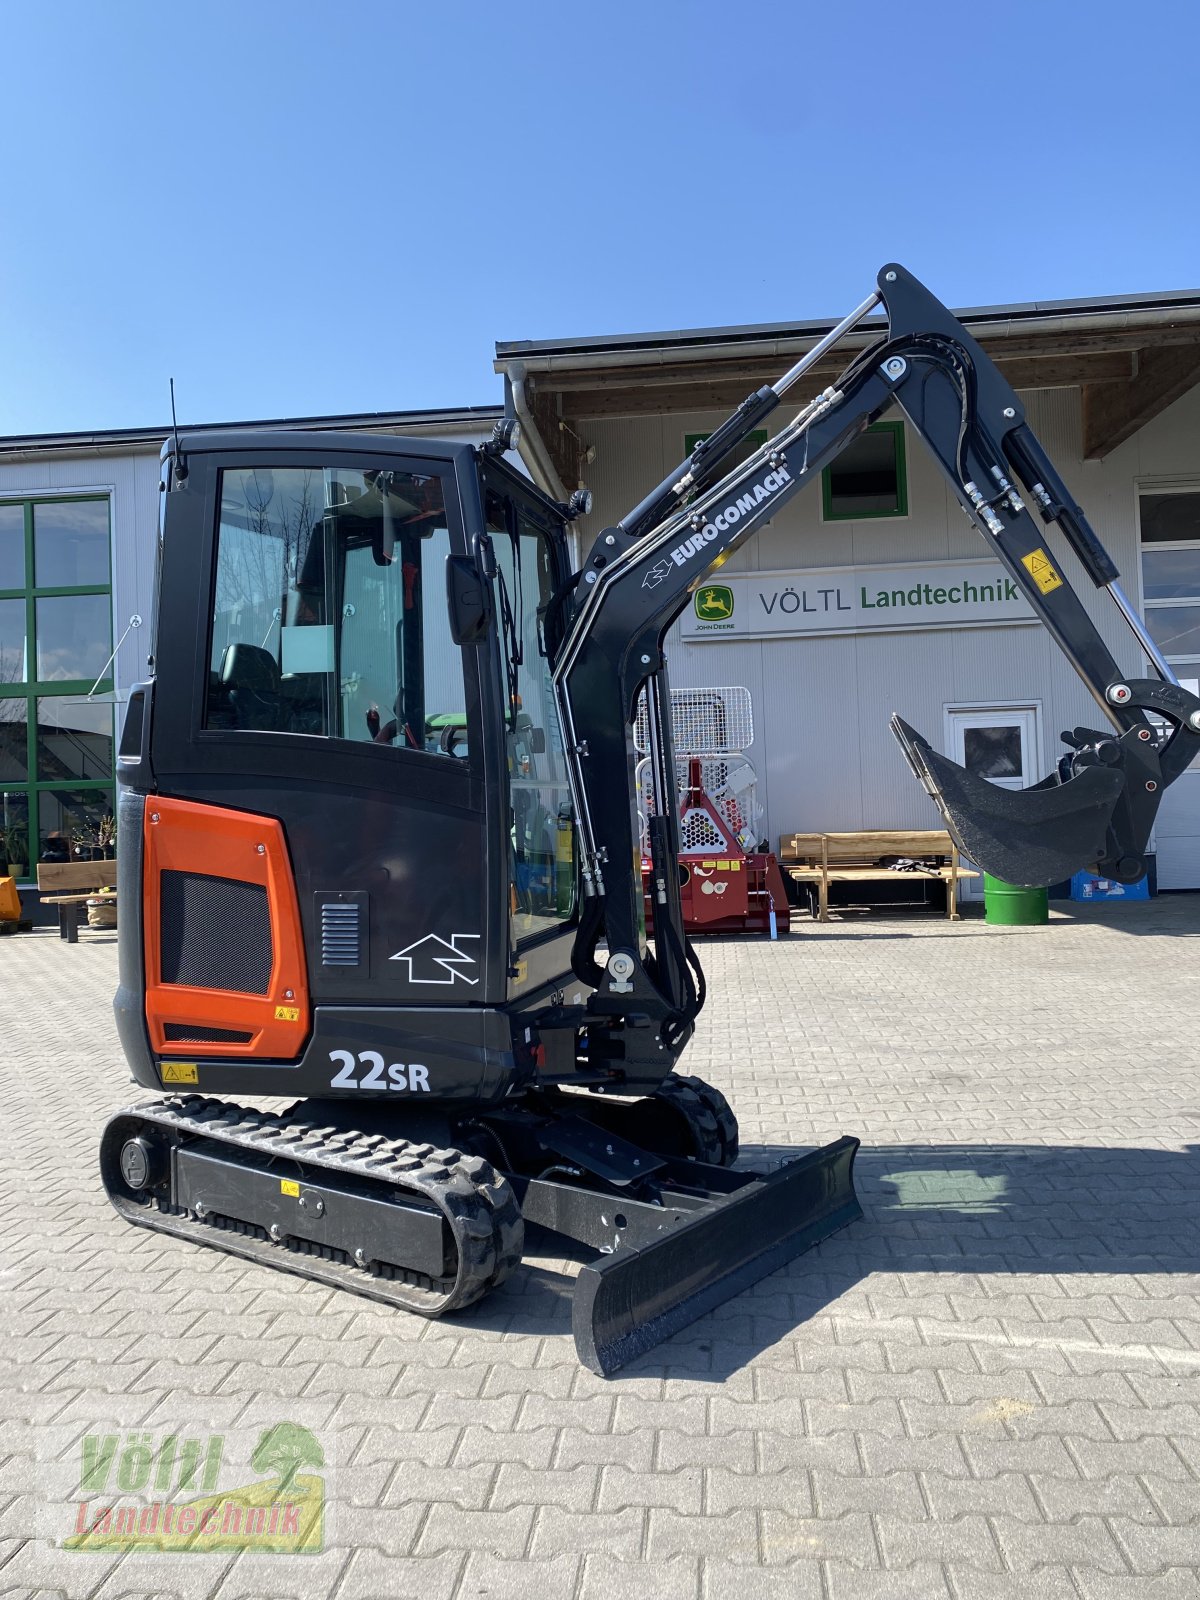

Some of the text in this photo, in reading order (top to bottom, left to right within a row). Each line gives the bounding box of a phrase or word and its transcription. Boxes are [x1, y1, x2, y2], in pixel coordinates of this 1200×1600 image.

[670, 466, 791, 567] EUROCOMACH
[759, 579, 1019, 615] VÖLTL Landtechnik
[328, 1049, 431, 1092] 22SR
